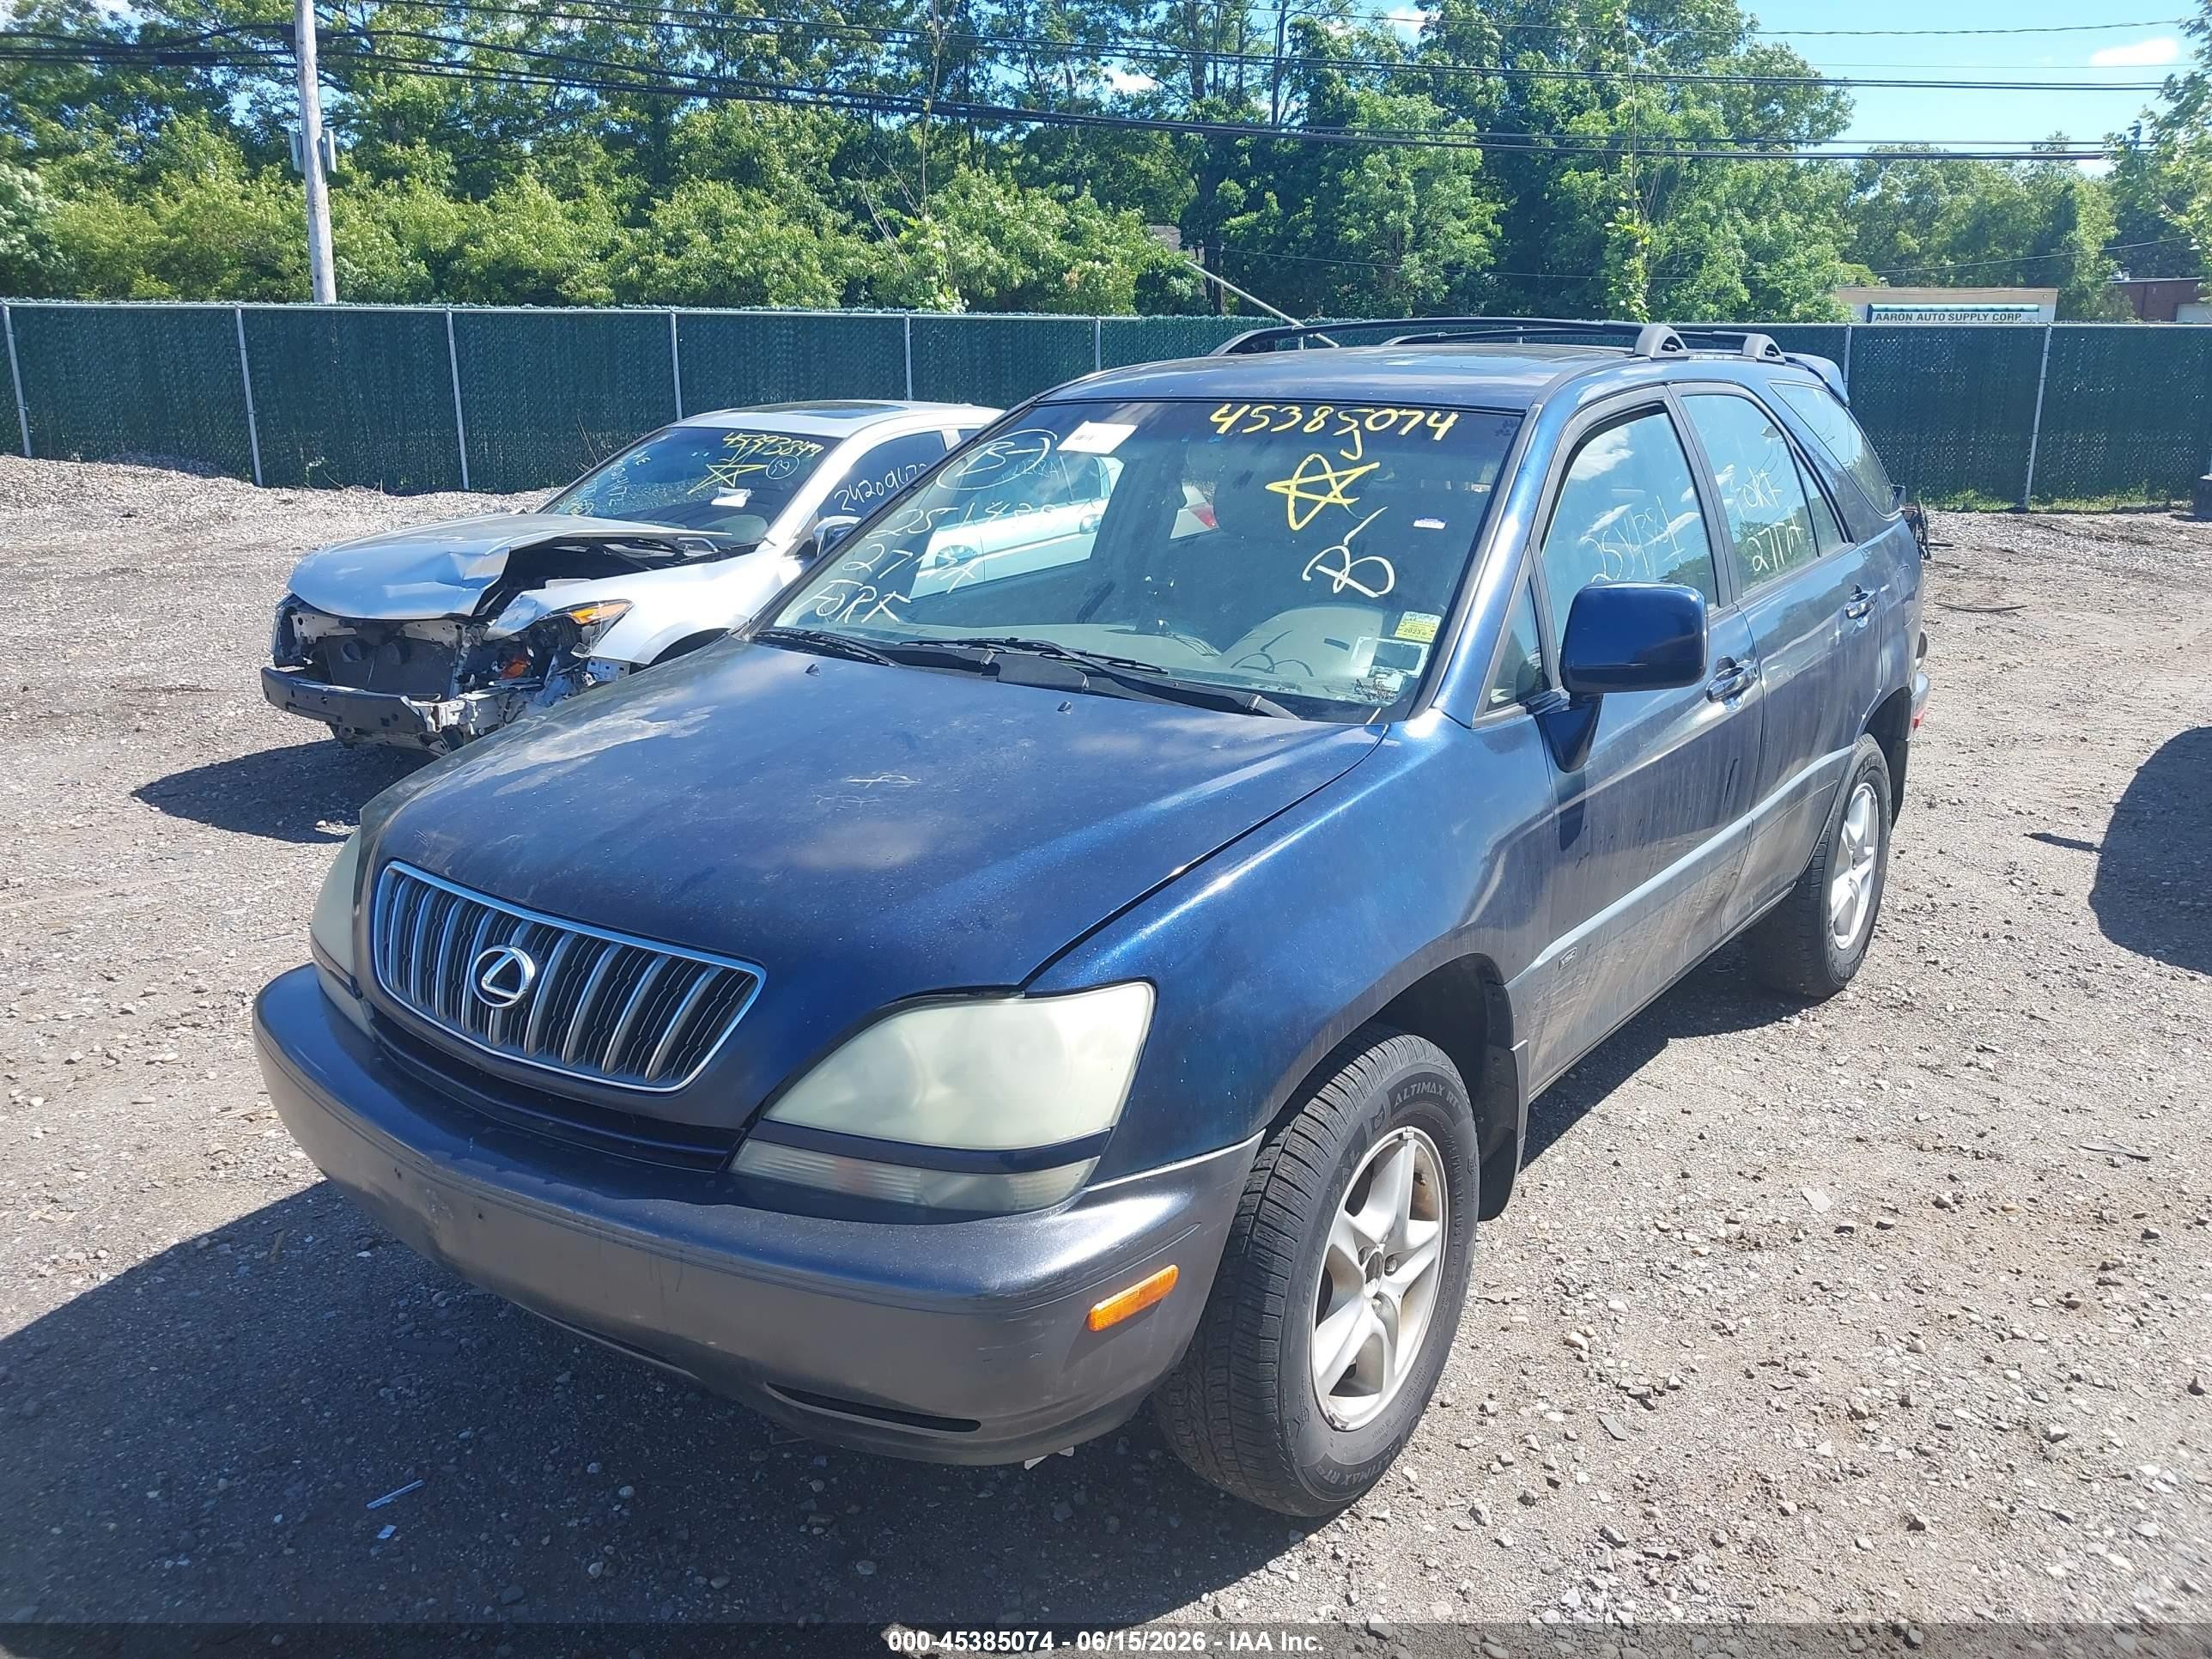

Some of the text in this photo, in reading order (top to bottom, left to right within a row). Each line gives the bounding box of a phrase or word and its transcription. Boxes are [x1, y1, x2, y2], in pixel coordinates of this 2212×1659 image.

[1875, 313, 1913, 321] AARON
[1917, 313, 1946, 321] AUTO
[1948, 313, 1990, 321] SUPPLY
[1209, 403, 1459, 441] 45385074
[1394, 1081, 1445, 1109] ALTIMAX
